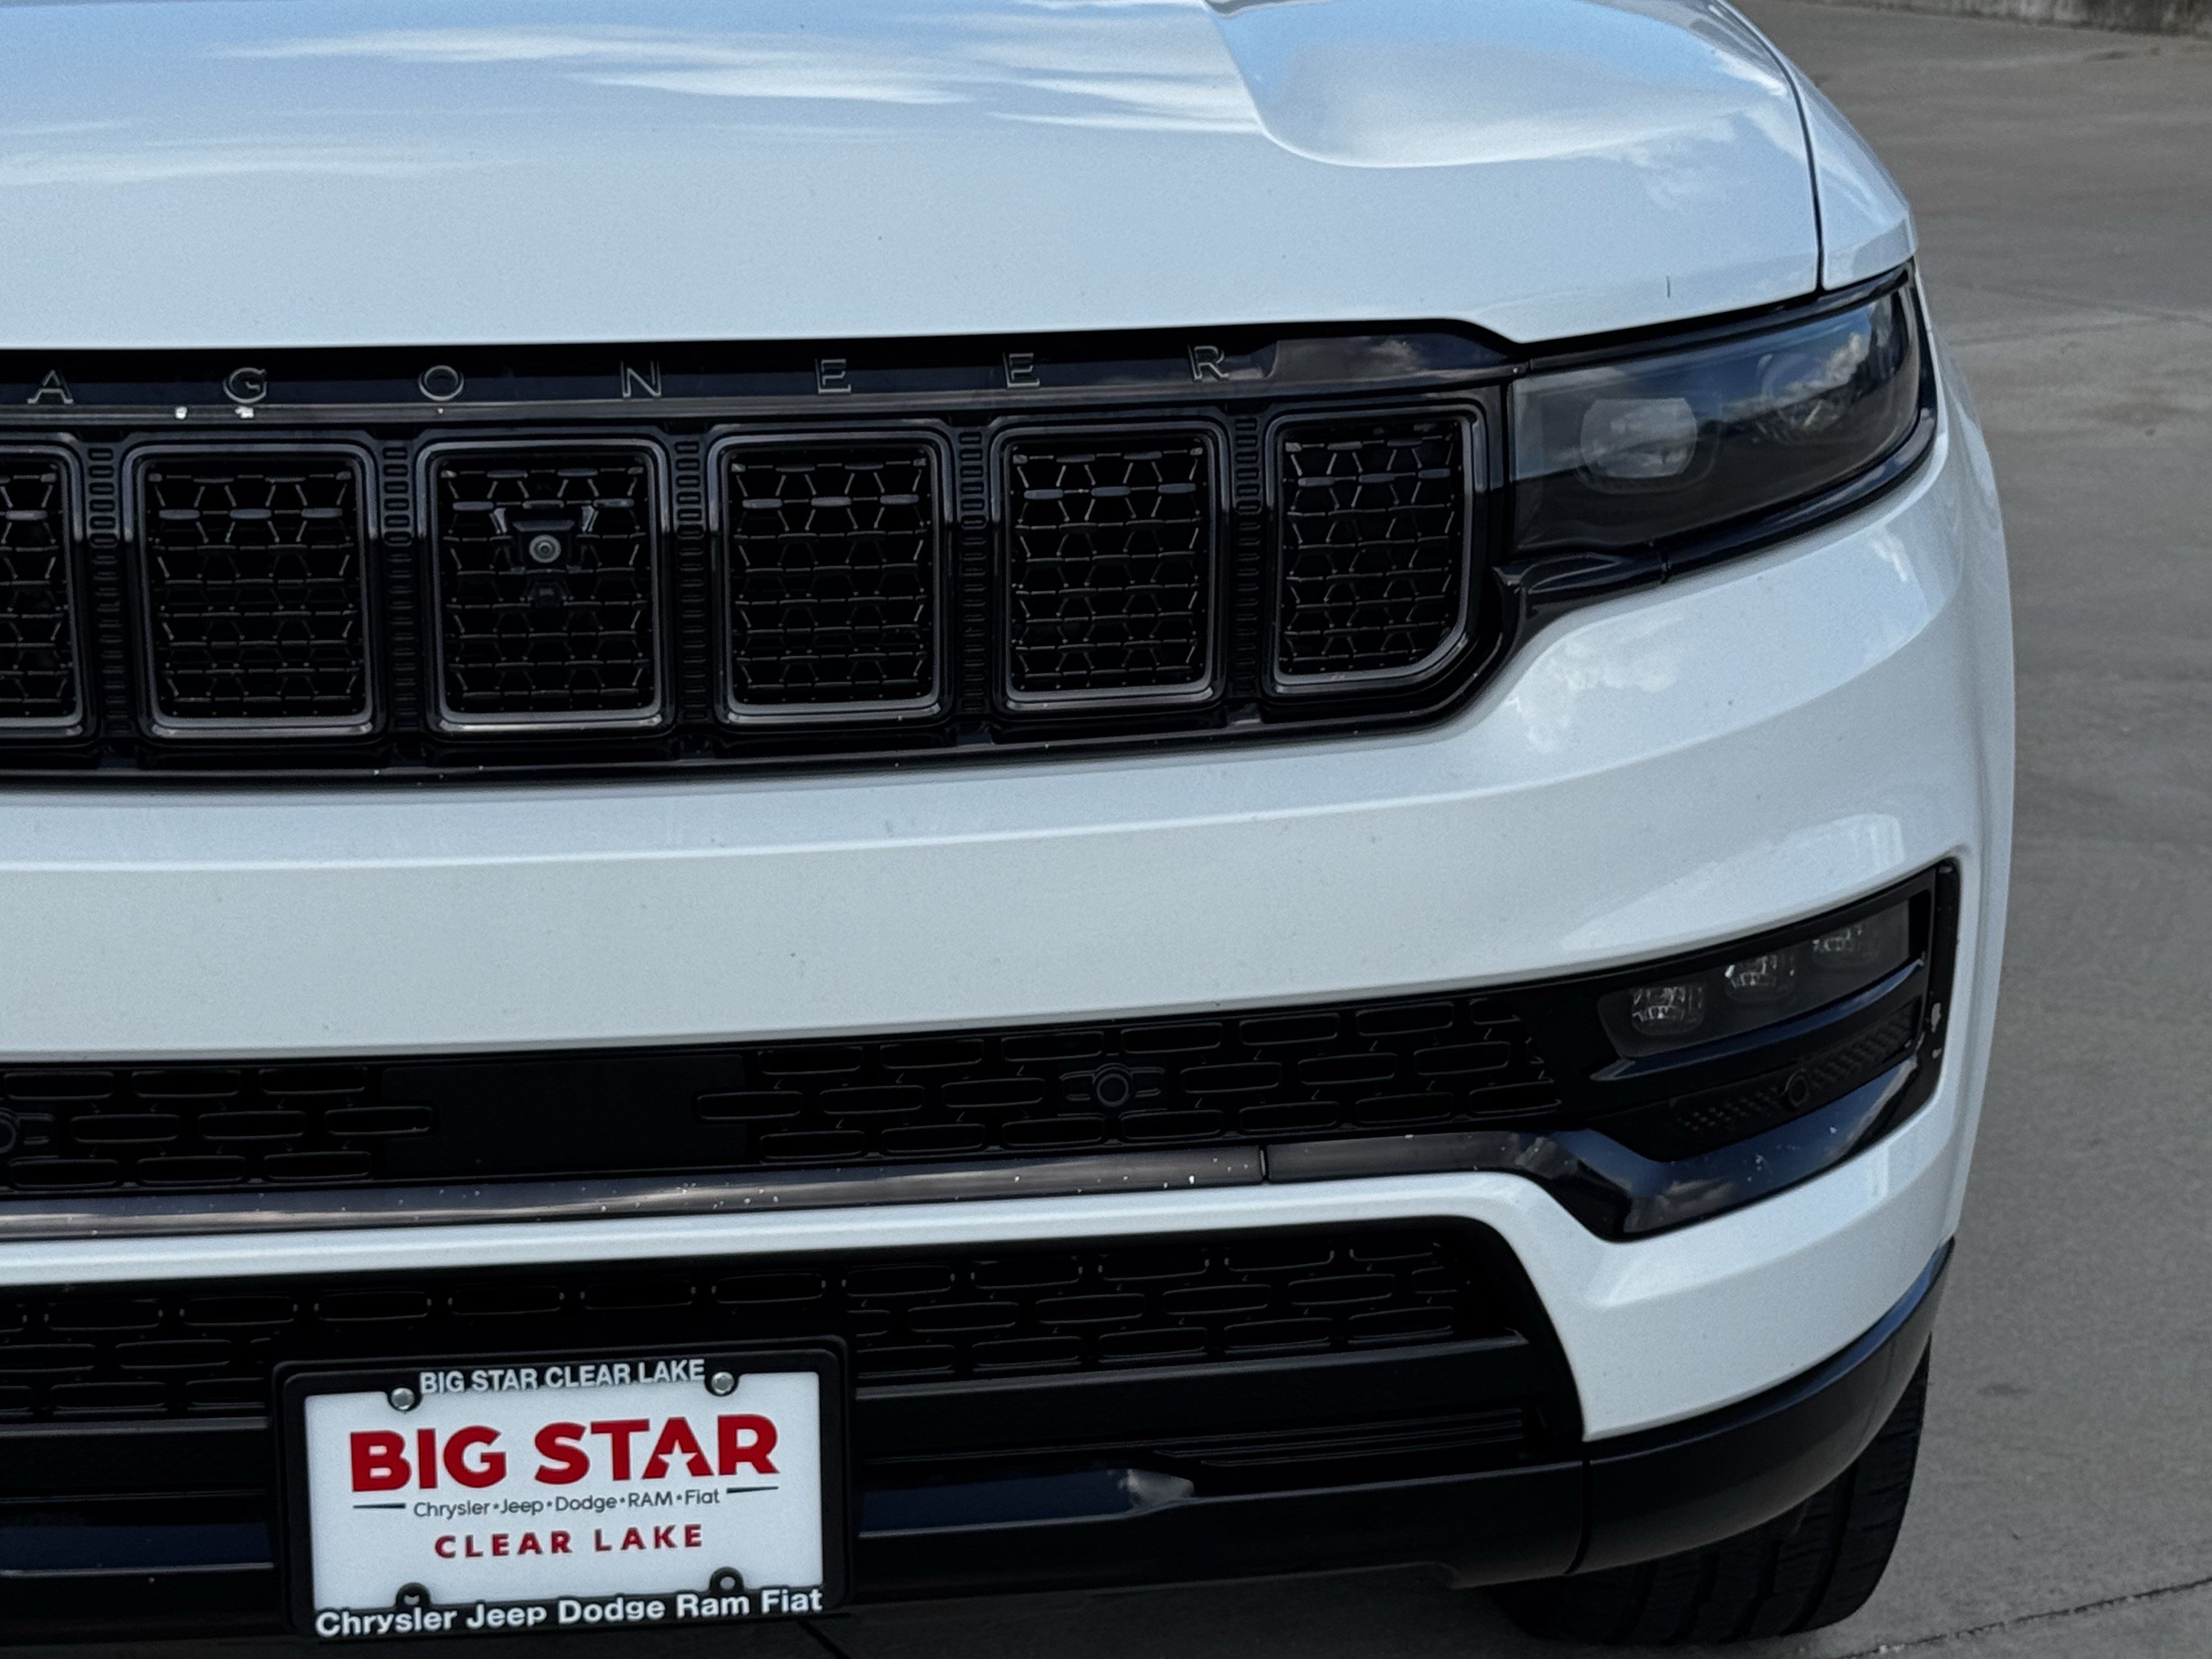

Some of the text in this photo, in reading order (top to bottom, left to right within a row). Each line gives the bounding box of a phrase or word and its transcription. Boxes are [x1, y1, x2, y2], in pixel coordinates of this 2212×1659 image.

[419, 1359, 706, 1395] BIG STAR CLEAR LAKE
[350, 1414, 780, 1492] BIG STAR
[435, 1524, 703, 1559] CLEAR LAKE
[315, 1588, 823, 1638] Chrysler Jeep Dodge Ram Fiat
